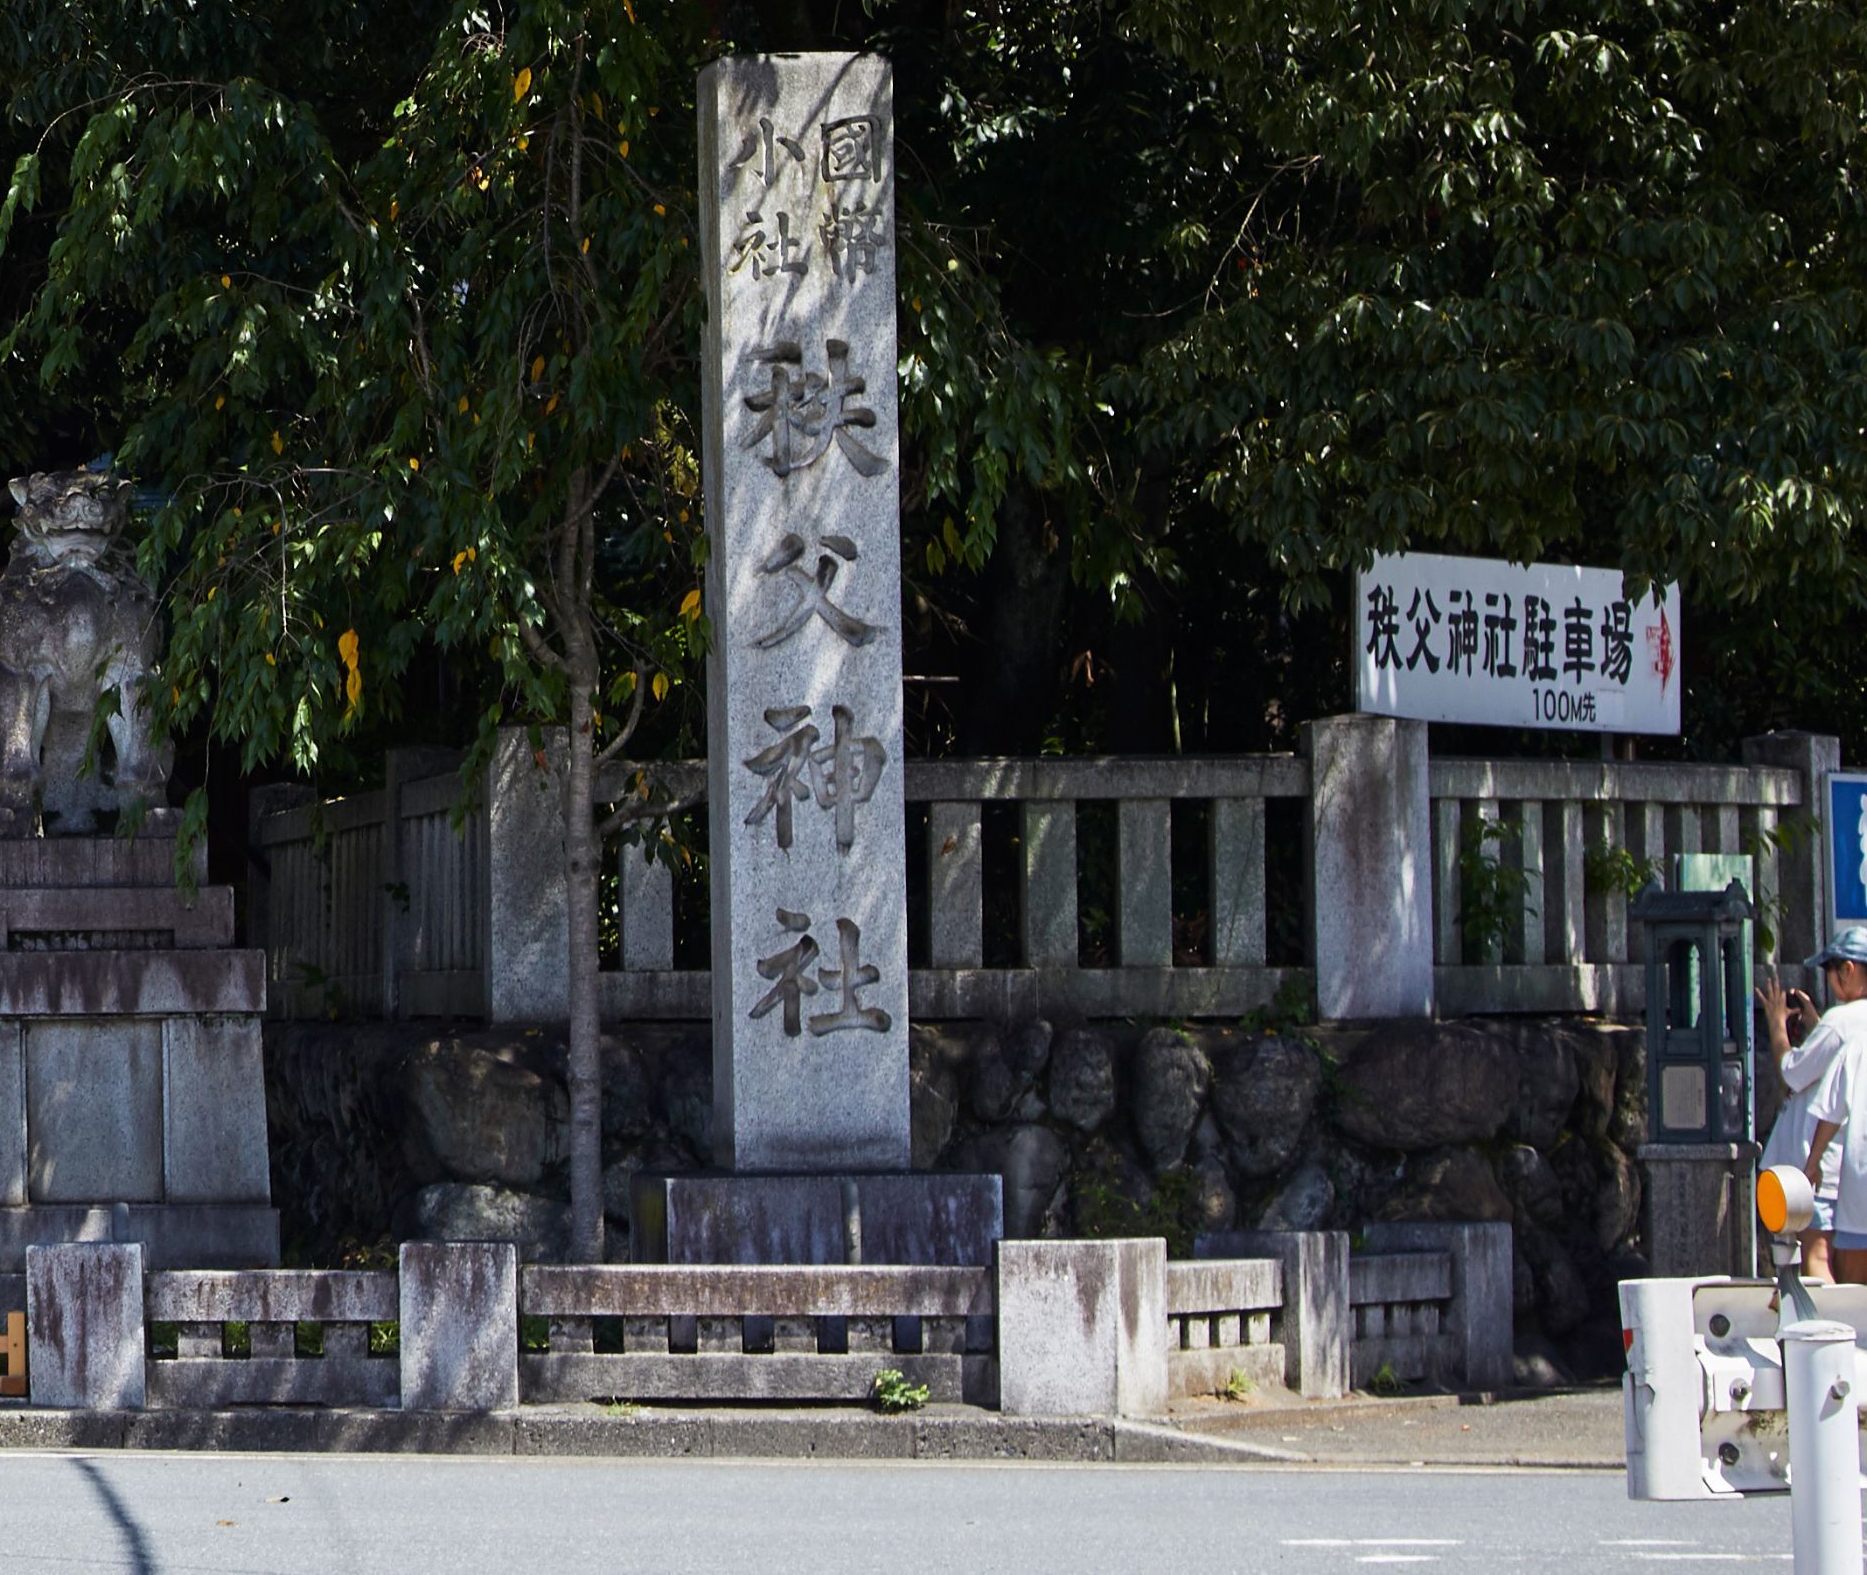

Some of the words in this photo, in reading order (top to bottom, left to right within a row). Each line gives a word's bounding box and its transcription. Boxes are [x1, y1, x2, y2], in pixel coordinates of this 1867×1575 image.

[728, 116, 809, 281] 小社
[739, 338, 894, 1039] 秩父神社
[1366, 583, 1635, 686] 秩父神社駐車場
